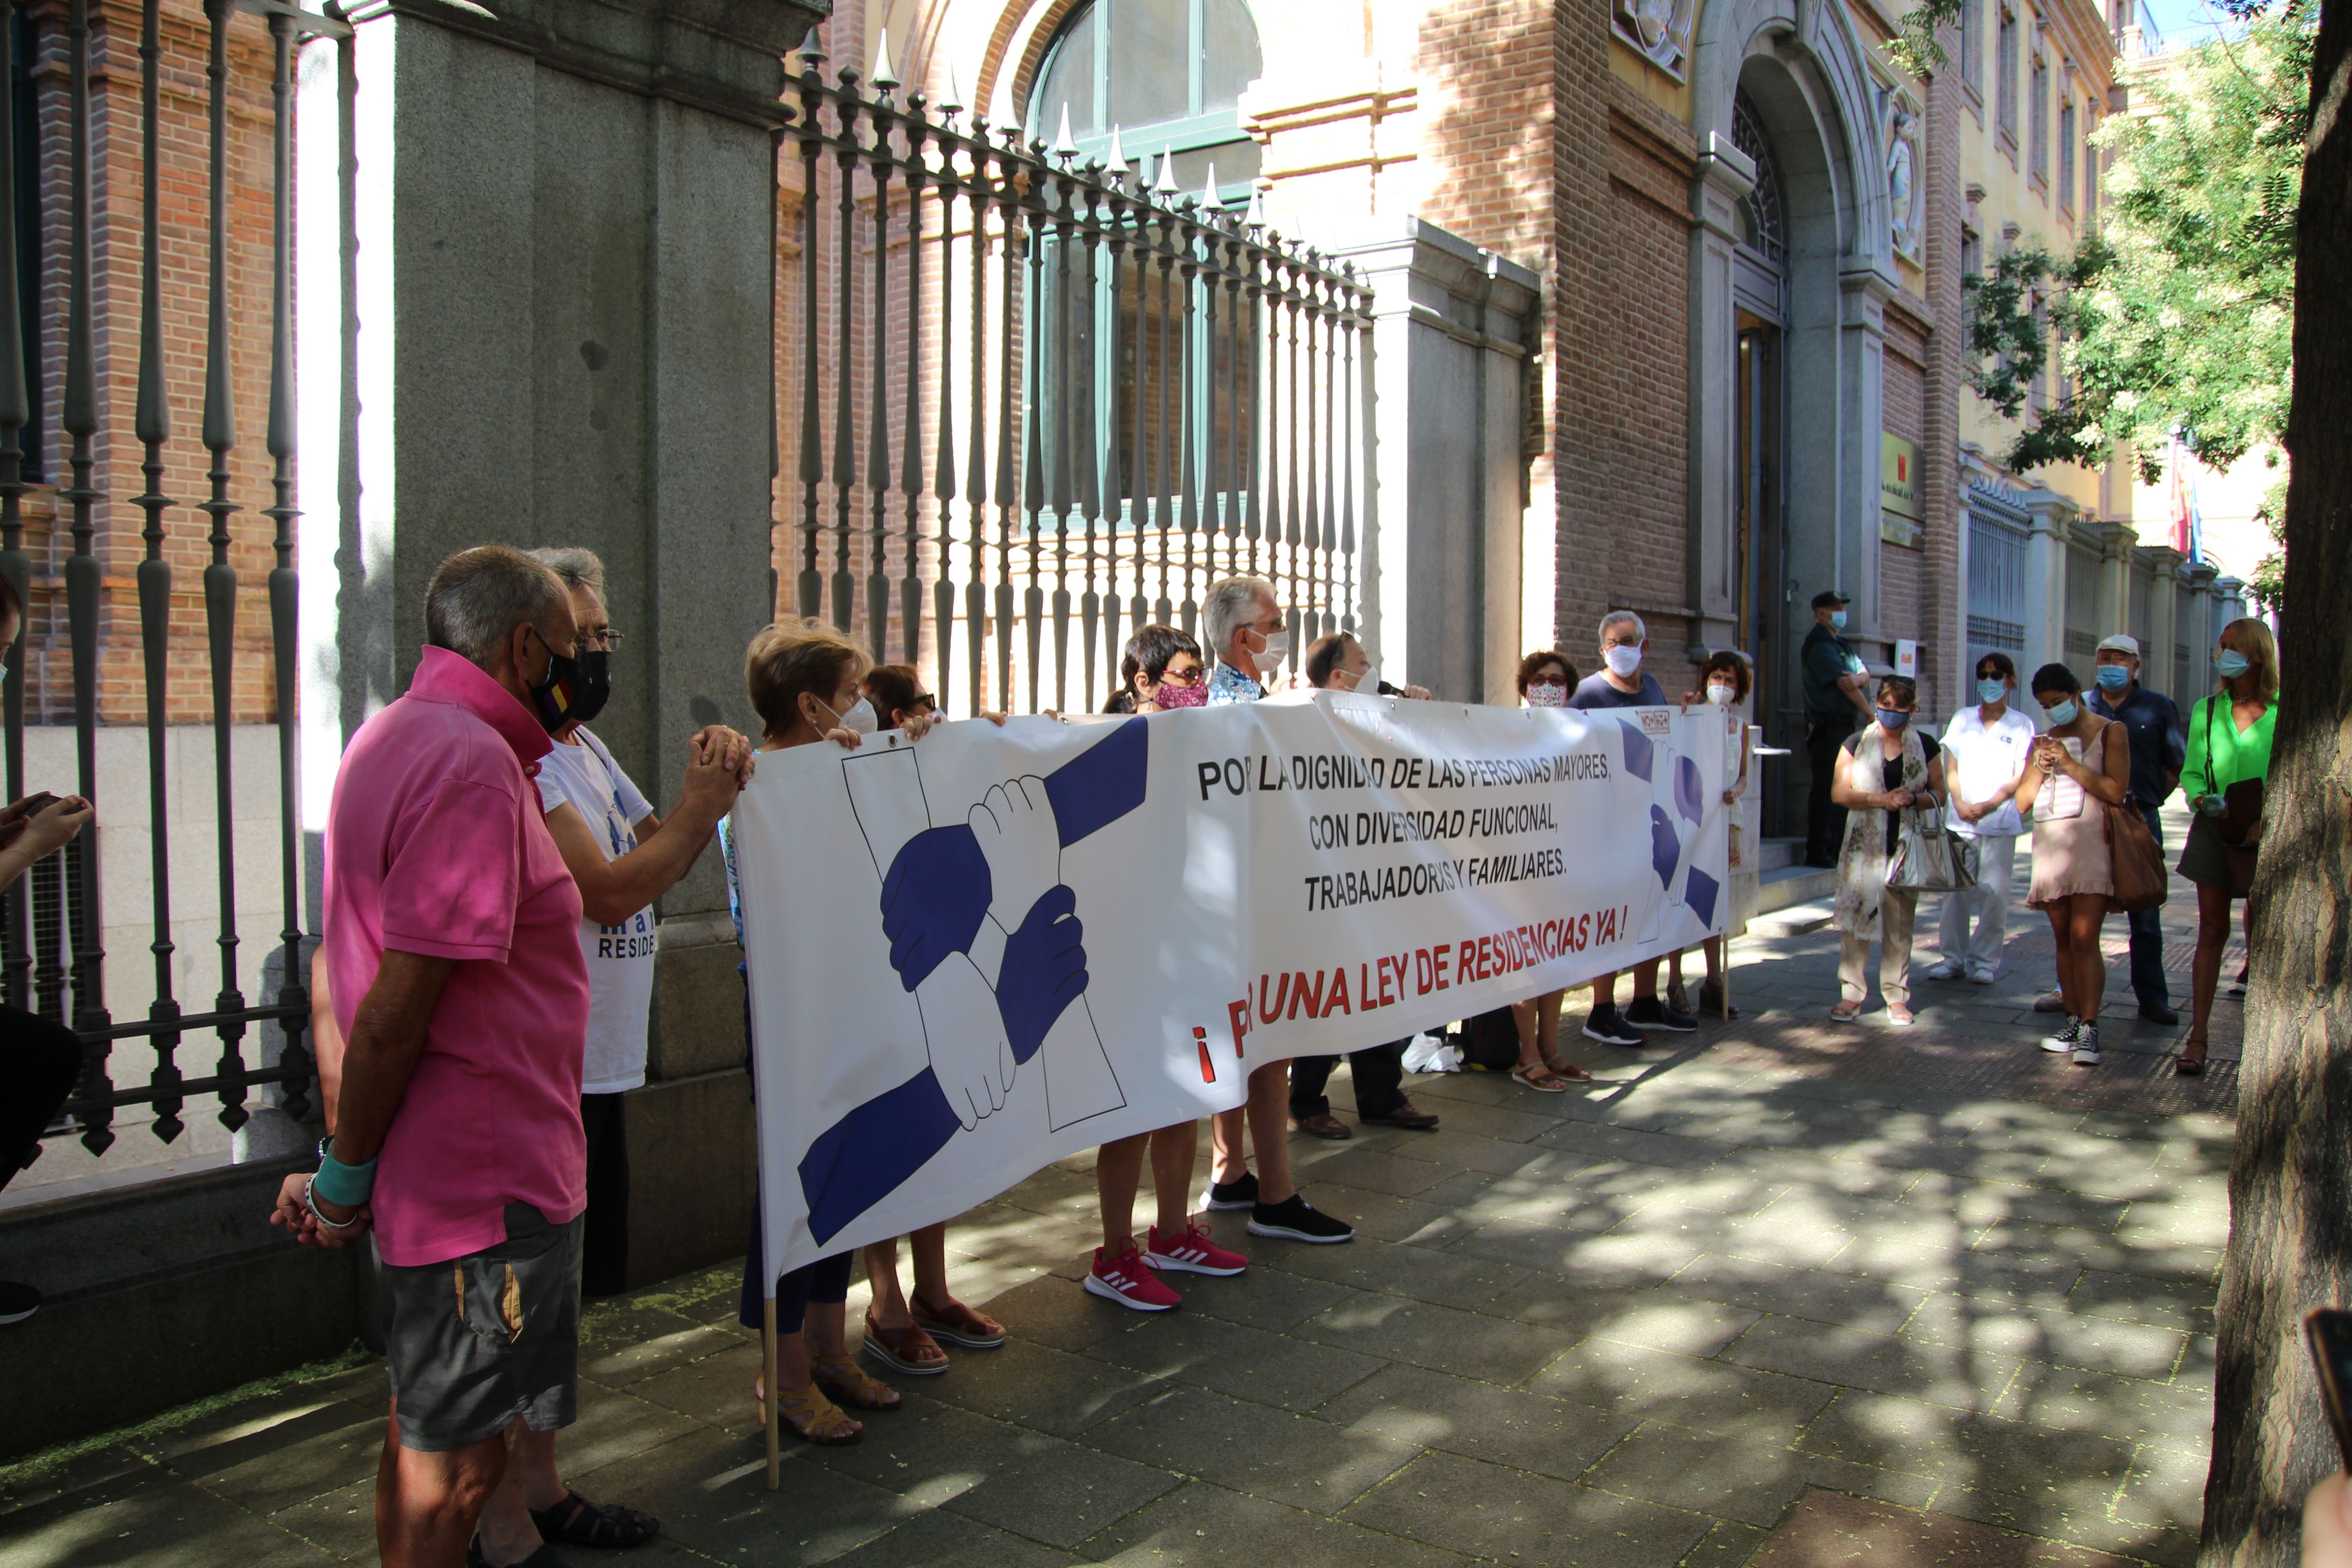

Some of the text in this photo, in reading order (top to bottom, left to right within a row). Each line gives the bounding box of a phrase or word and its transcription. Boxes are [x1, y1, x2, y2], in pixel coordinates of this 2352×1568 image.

[1259, 755, 1292, 791] LA
[1293, 755, 1384, 789] DIGNIDAD
[1391, 758, 1423, 789] DE
[1428, 758, 1465, 788] LAS
[1465, 757, 1551, 788] PERSONAS
[1553, 754, 1611, 783] MAYORES,
[1309, 803, 1558, 850] CON DIVERSIDAD FUNCIONAL,
[1305, 848, 1567, 911] TRABAJADORXS Y FAMILIARES.
[598, 935, 654, 959] RESIDE
[1259, 967, 1351, 1024] UNA
[1361, 952, 1408, 1011] LEY
[1415, 944, 1450, 995] DE
[1457, 914, 1590, 985] RESIDENCIAS
